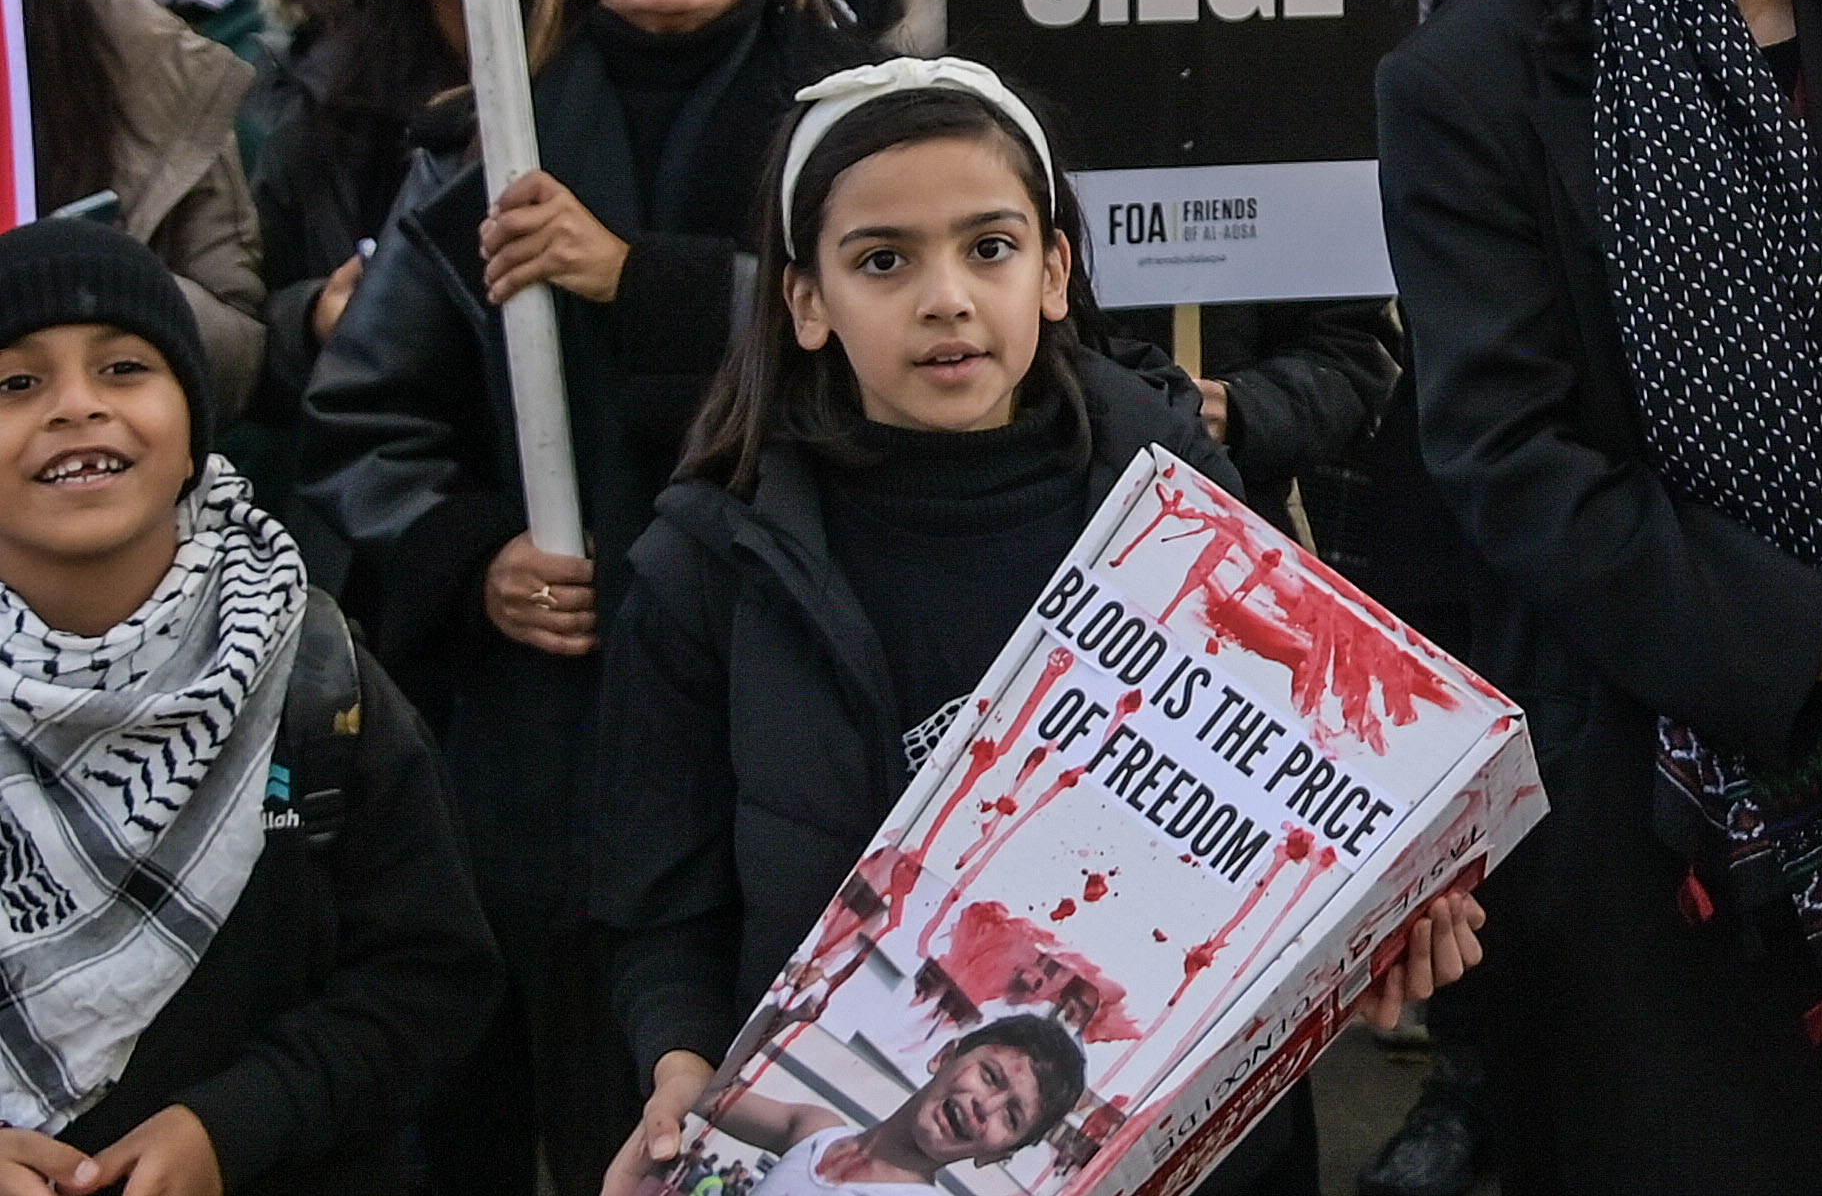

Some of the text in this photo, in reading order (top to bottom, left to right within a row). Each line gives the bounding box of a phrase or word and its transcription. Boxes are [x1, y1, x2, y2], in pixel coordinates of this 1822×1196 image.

[1109, 202, 1168, 245] FOA
[1183, 198, 1258, 222] FRIENDS
[1036, 566, 1394, 857] BLOOD IS THE PRICE
[1038, 688, 1272, 884] OF FREEDOM
